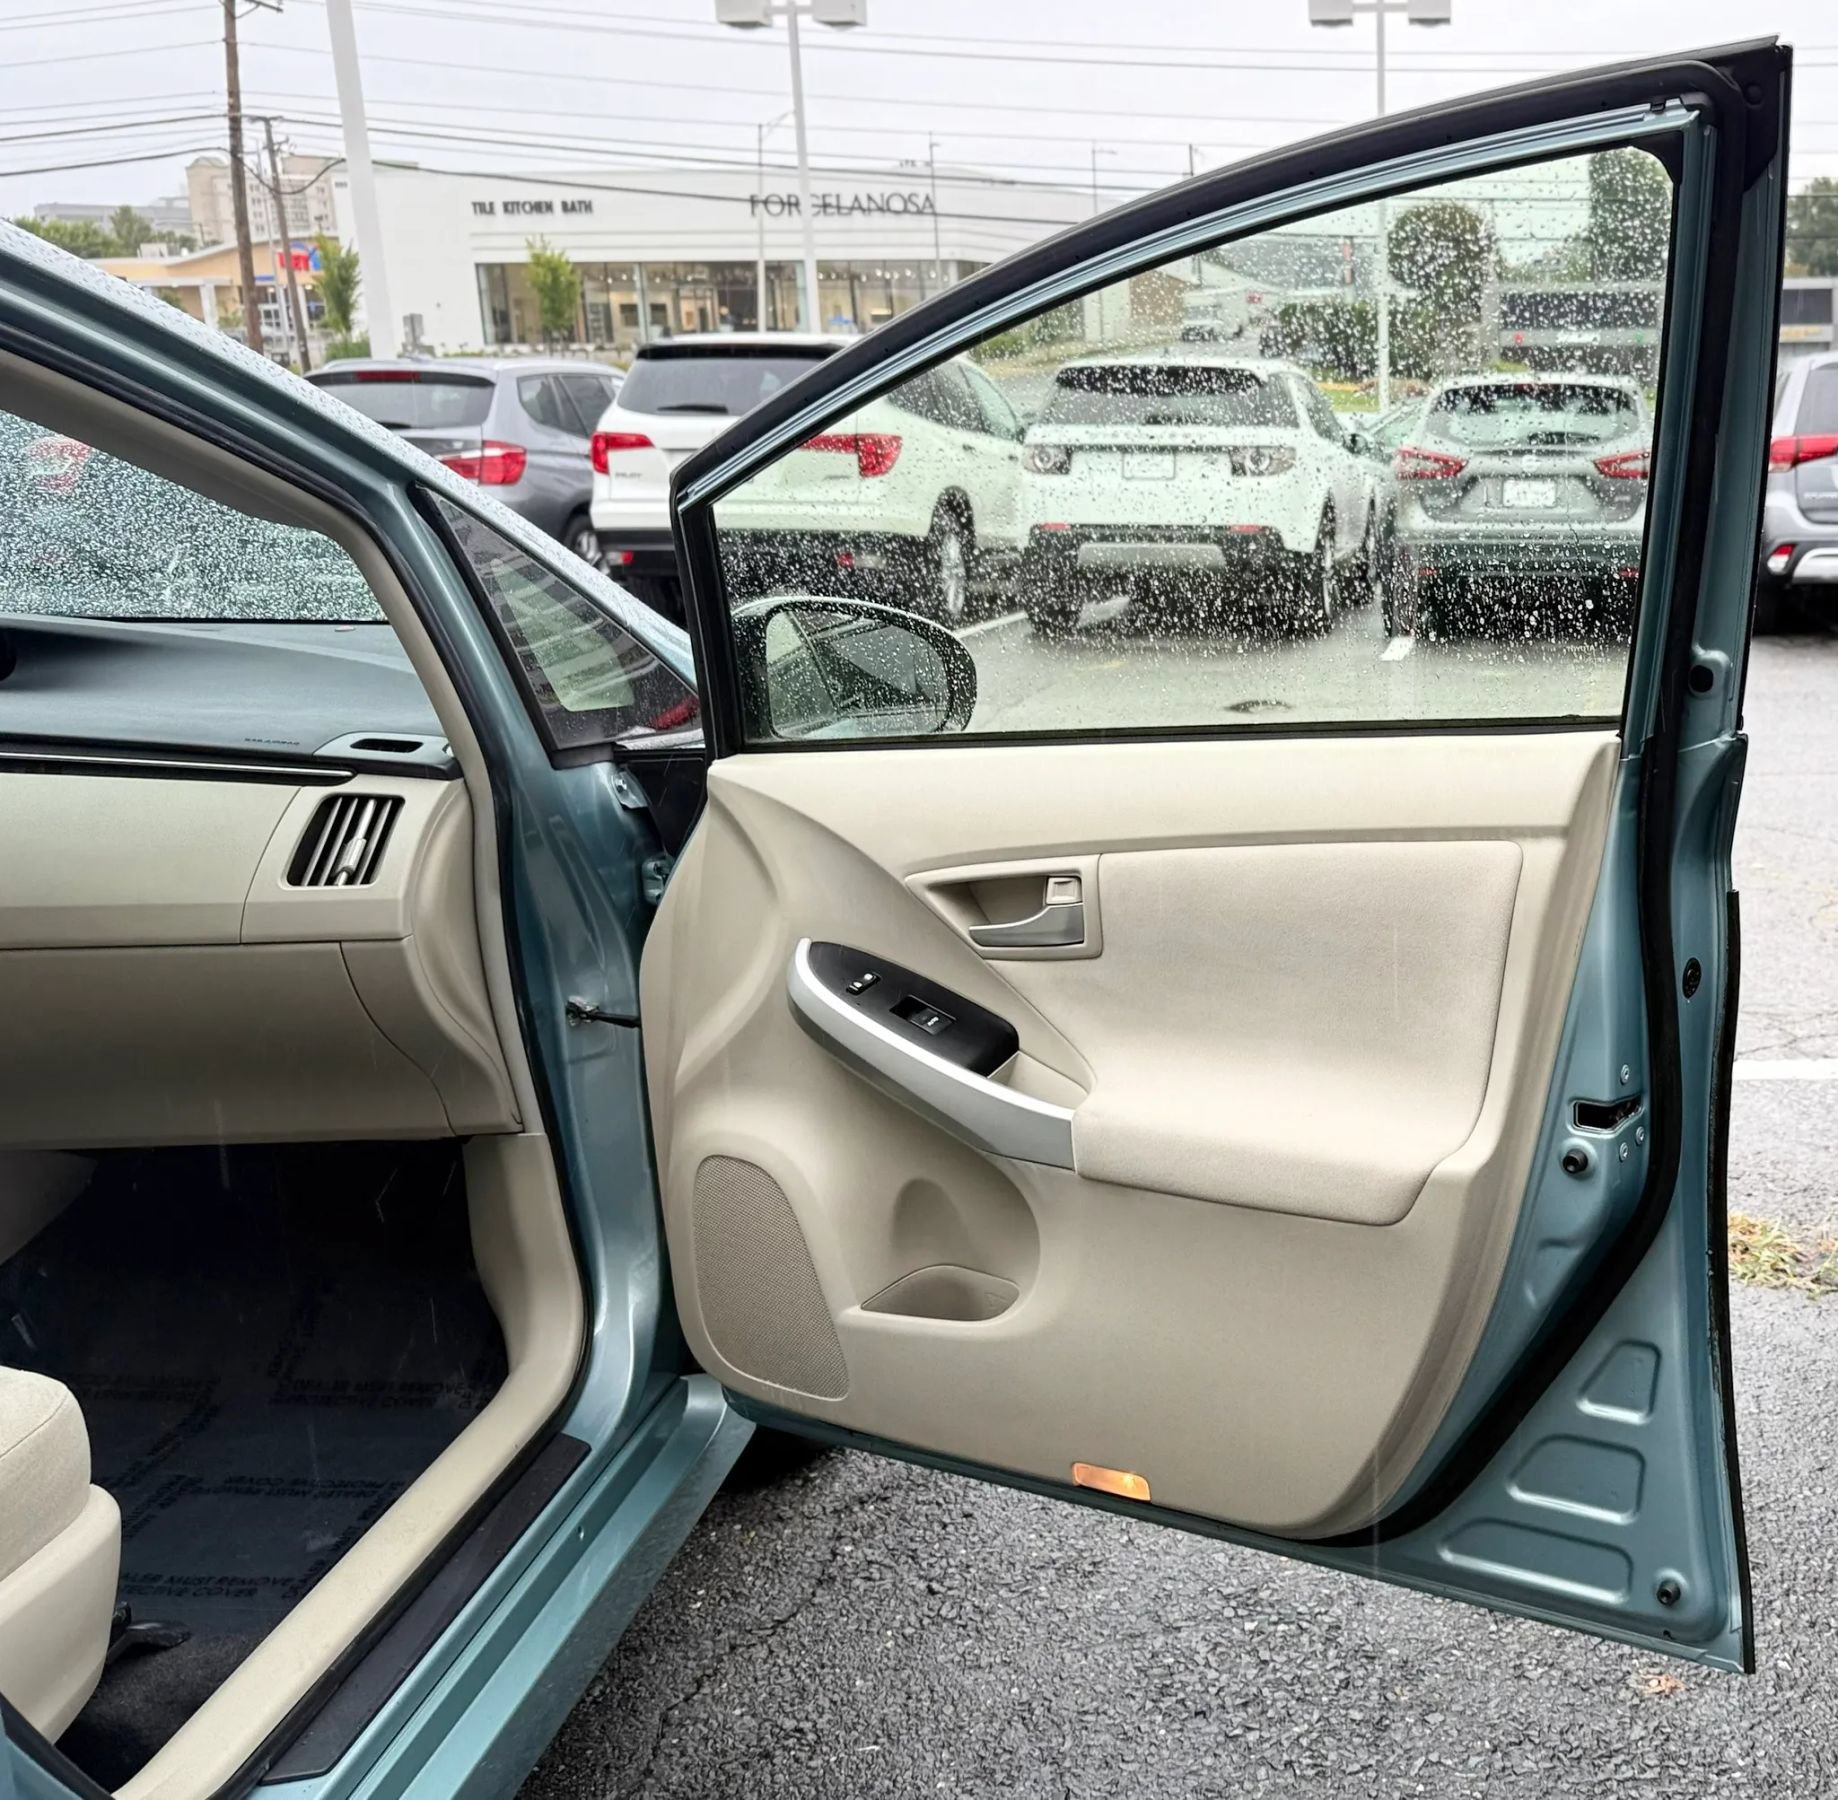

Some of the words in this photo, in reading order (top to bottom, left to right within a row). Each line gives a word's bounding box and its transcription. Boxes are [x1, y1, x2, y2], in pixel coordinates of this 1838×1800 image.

[471, 201, 495, 215] TILE
[502, 201, 554, 215] KITCHEN
[561, 200, 593, 214] BATH
[164, 1575, 216, 1585] MUST
[216, 1576, 294, 1586] REMOVE
[192, 1586, 258, 1598] COVER
